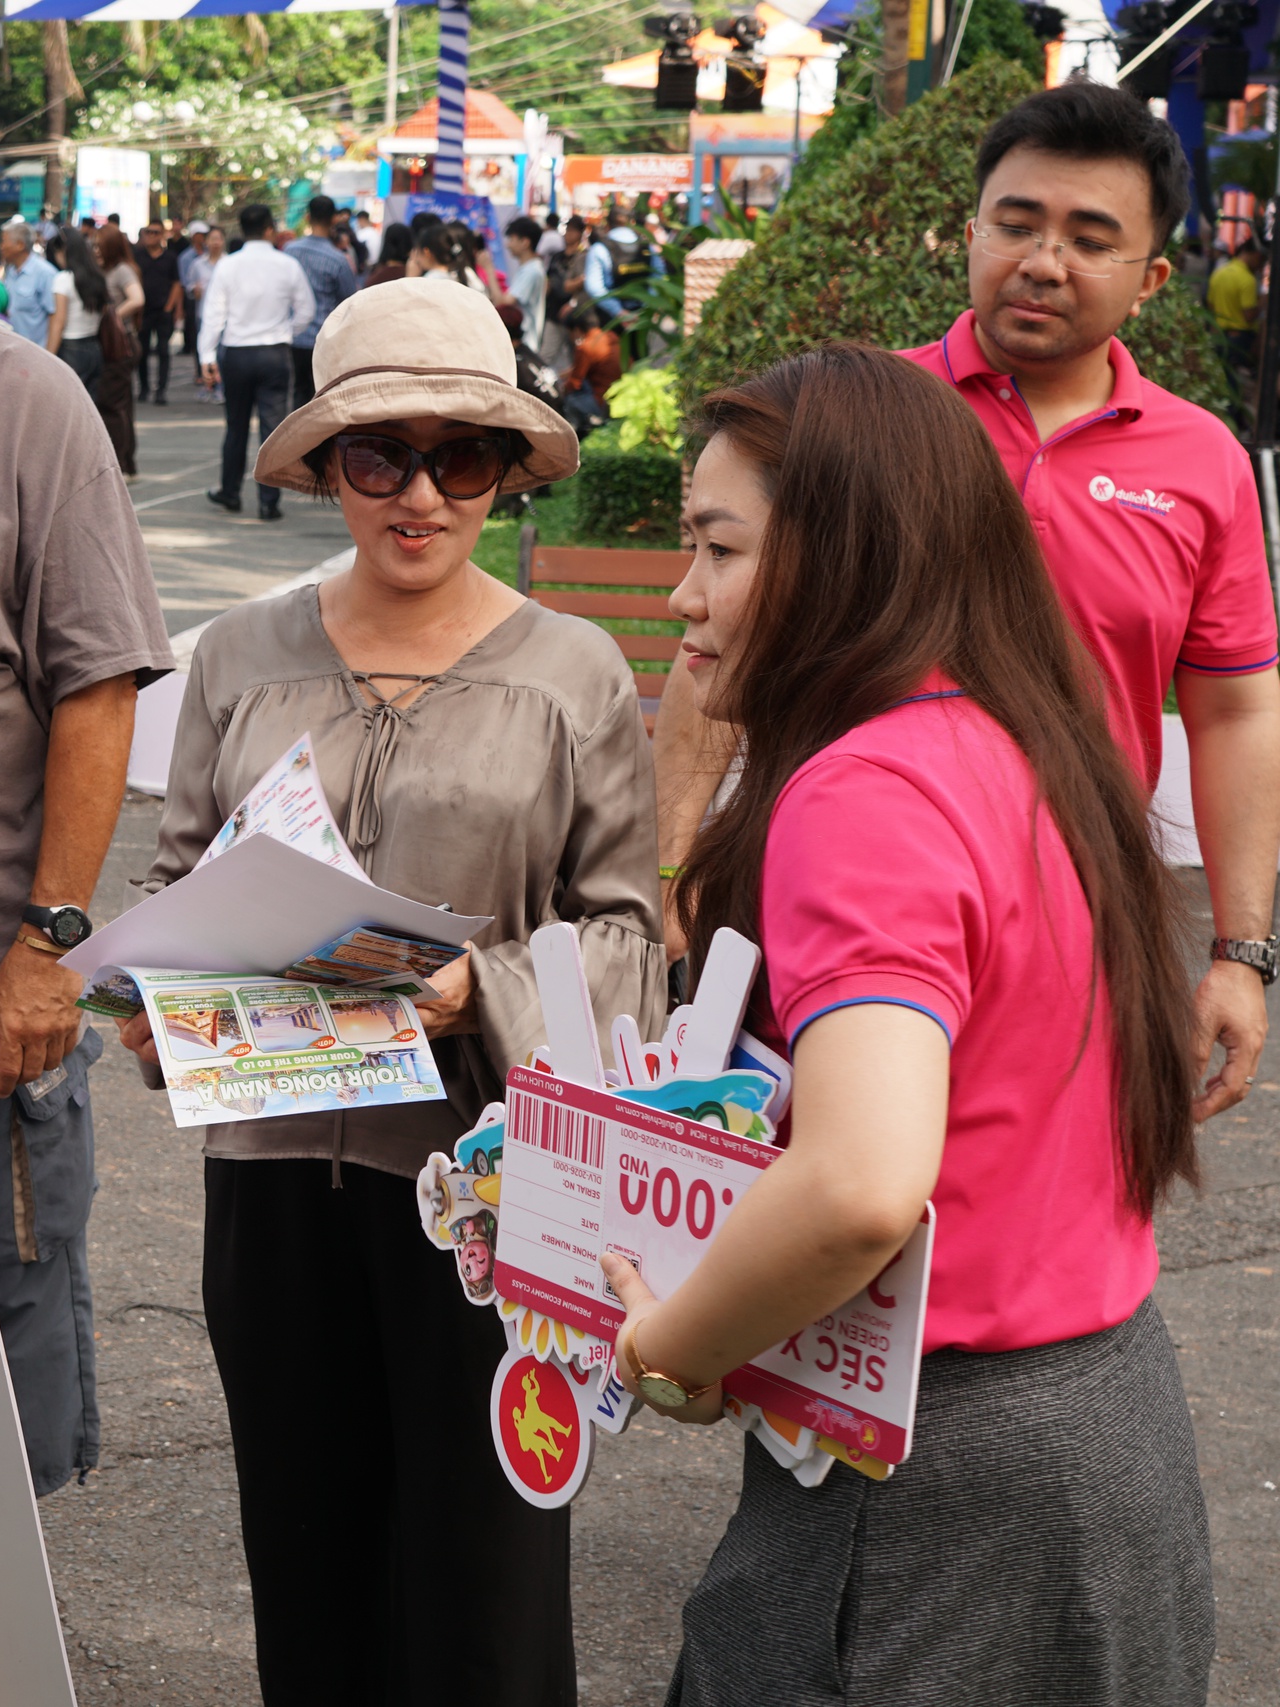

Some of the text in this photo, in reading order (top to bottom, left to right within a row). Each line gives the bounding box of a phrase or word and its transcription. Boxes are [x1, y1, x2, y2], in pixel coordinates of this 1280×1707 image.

[602, 158, 689, 179] DANANG
[294, 1054, 328, 1067] KHÔNG
[330, 1051, 357, 1061] TOUR
[195, 1064, 408, 1106] TOUR ĐÔNG NAM Á
[513, 1071, 555, 1092] DU LỊCH VIỆT
[615, 1104, 676, 1132] dulichviet.com.vn
[690, 1128, 708, 1141] HCM
[708, 1134, 721, 1146] TP.
[621, 1127, 724, 1170] SERIAL NO: DLV-2026-0001
[742, 1143, 759, 1160] Ông
[553, 1160, 602, 1185] DLV-2026-0001
[619, 1153, 650, 1178] VND
[562, 1179, 601, 1200] SERIAL NO:
[580, 1218, 600, 1232] DATE
[541, 1233, 597, 1262] PHONE NUMBER
[573, 1276, 595, 1291] NAME
[511, 1279, 592, 1318] PREMIUM ECONOMY CLASS
[849, 1309, 894, 1332] AMOUNT
[839, 1320, 890, 1352] GREEN
[815, 1335, 887, 1393] SÉC
